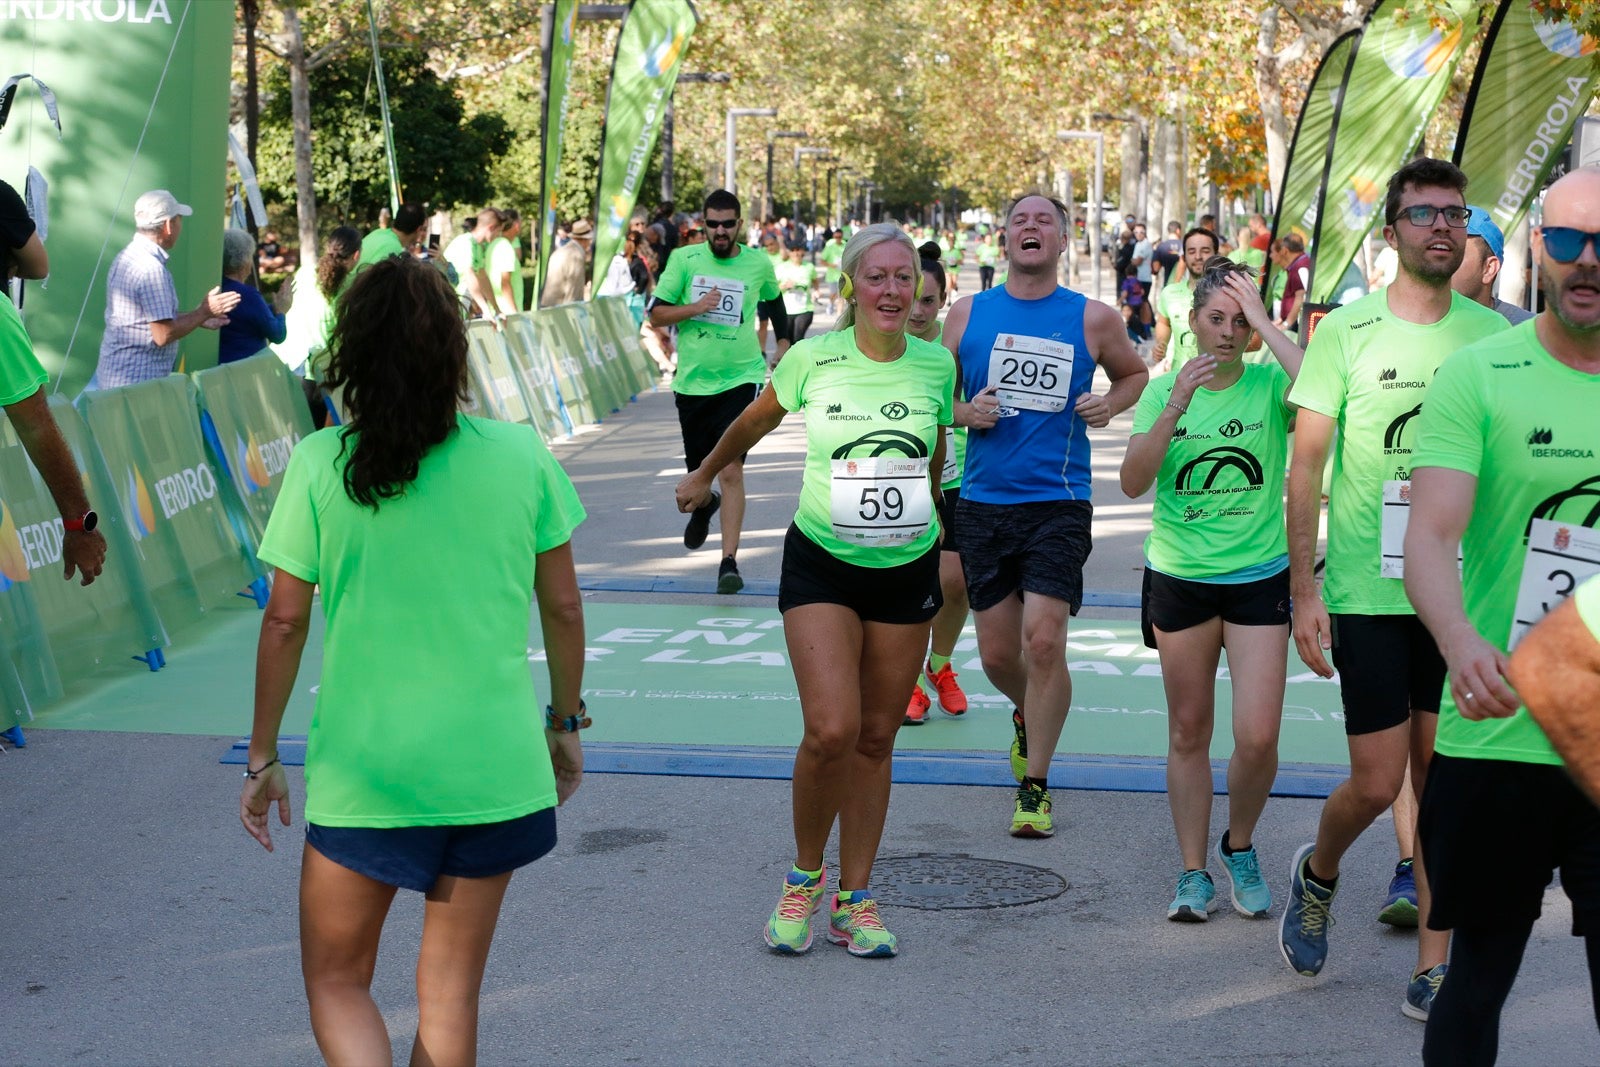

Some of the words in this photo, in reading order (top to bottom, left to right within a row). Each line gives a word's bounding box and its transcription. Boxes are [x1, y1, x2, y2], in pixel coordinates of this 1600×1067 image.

[0, 0, 172, 24] RDROLA
[1493, 76, 1589, 222] IBERDROLA
[1350, 317, 1374, 330] luanvi
[815, 356, 840, 367] luanvi
[1000, 357, 1059, 390] 295
[1382, 381, 1426, 390] IBERDROLA
[828, 414, 873, 422] IBERDROLA
[1532, 448, 1594, 459] IBERDROLA
[1231, 485, 1262, 493] IGUALDAD
[859, 486, 904, 521] 59
[593, 627, 766, 646] EN
[640, 649, 786, 666] LA
